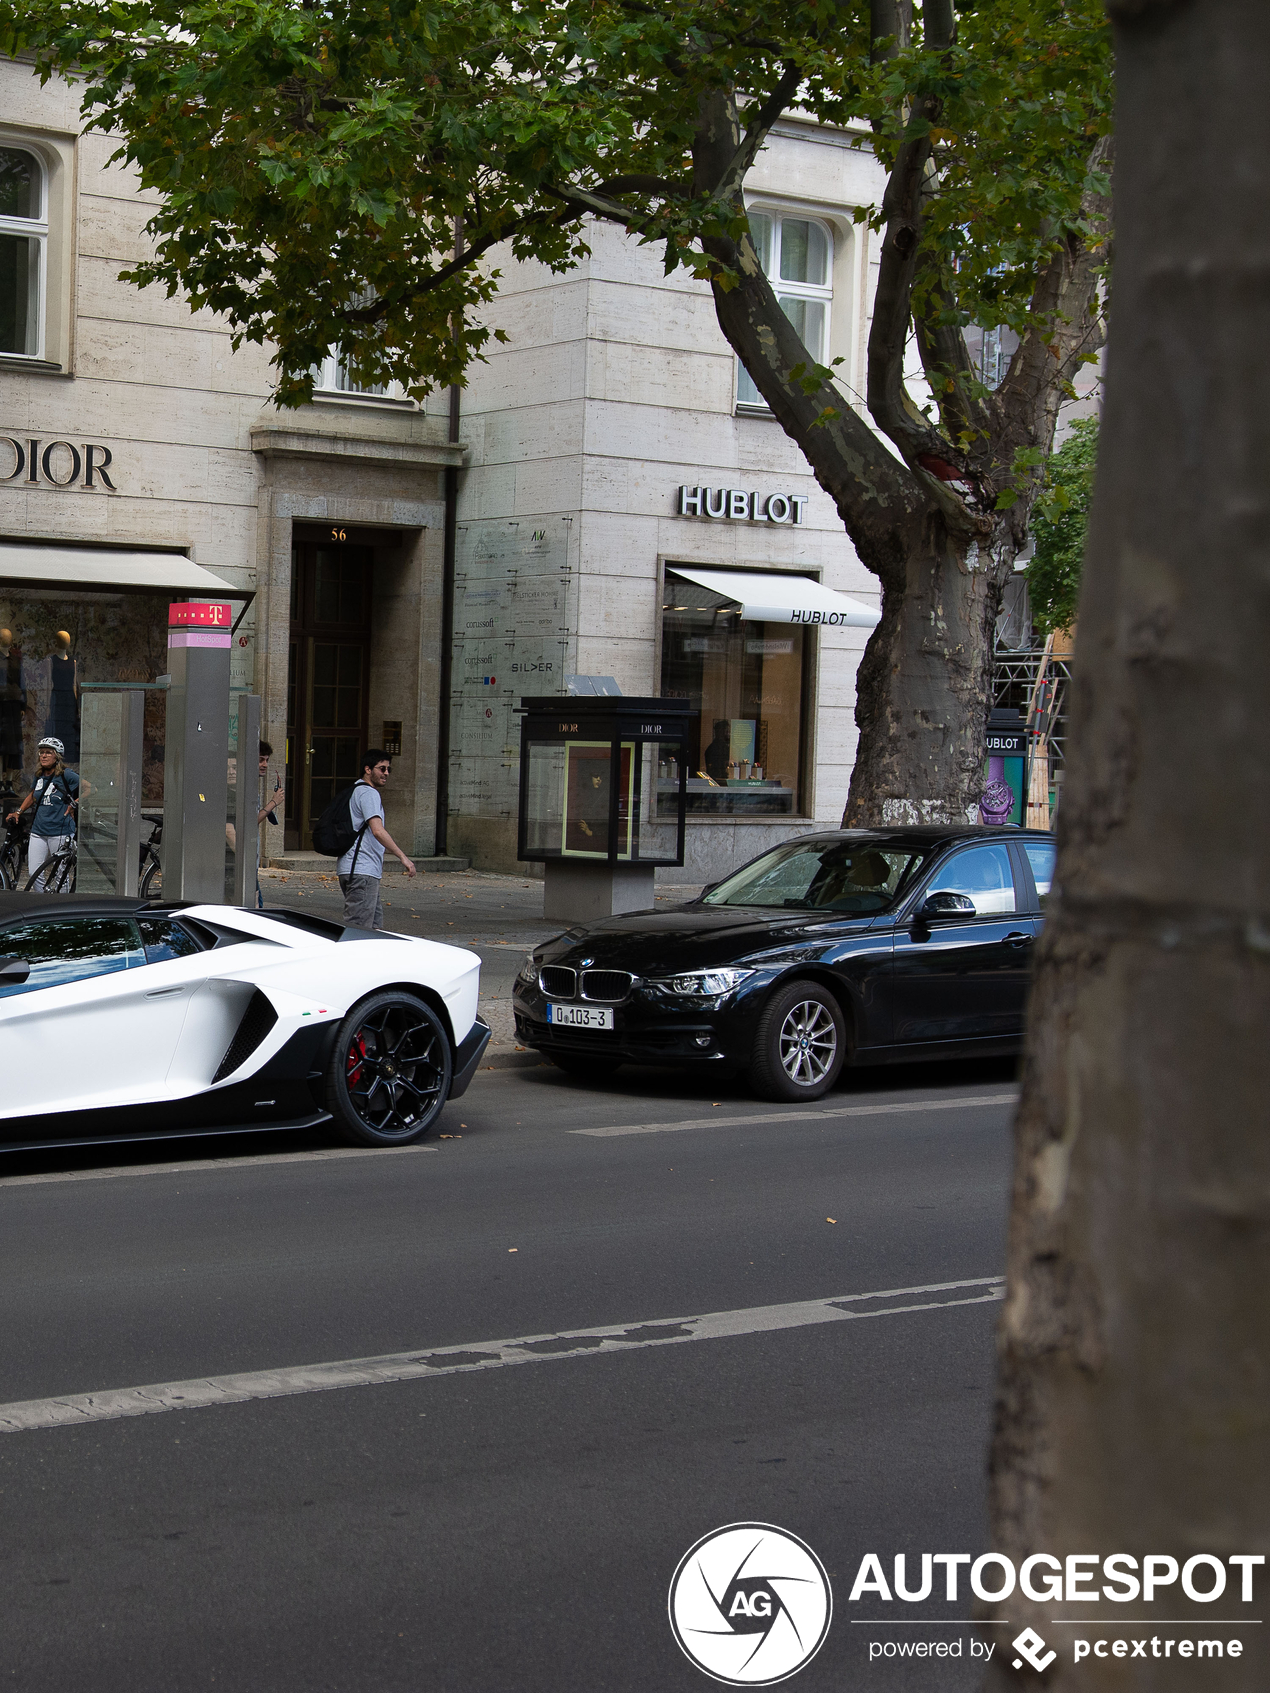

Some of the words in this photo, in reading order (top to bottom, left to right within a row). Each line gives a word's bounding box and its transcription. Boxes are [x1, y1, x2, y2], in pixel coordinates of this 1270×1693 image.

[678, 485, 809, 525] HUBLOT
[331, 527, 347, 541] 56
[790, 609, 848, 626] HUBLOT
[196, 634, 222, 645] HotSpot
[558, 723, 579, 733] DIOR
[641, 724, 663, 734] DIOR
[986, 738, 1019, 749] UBLOT
[570, 1008, 606, 1027] 103-3
